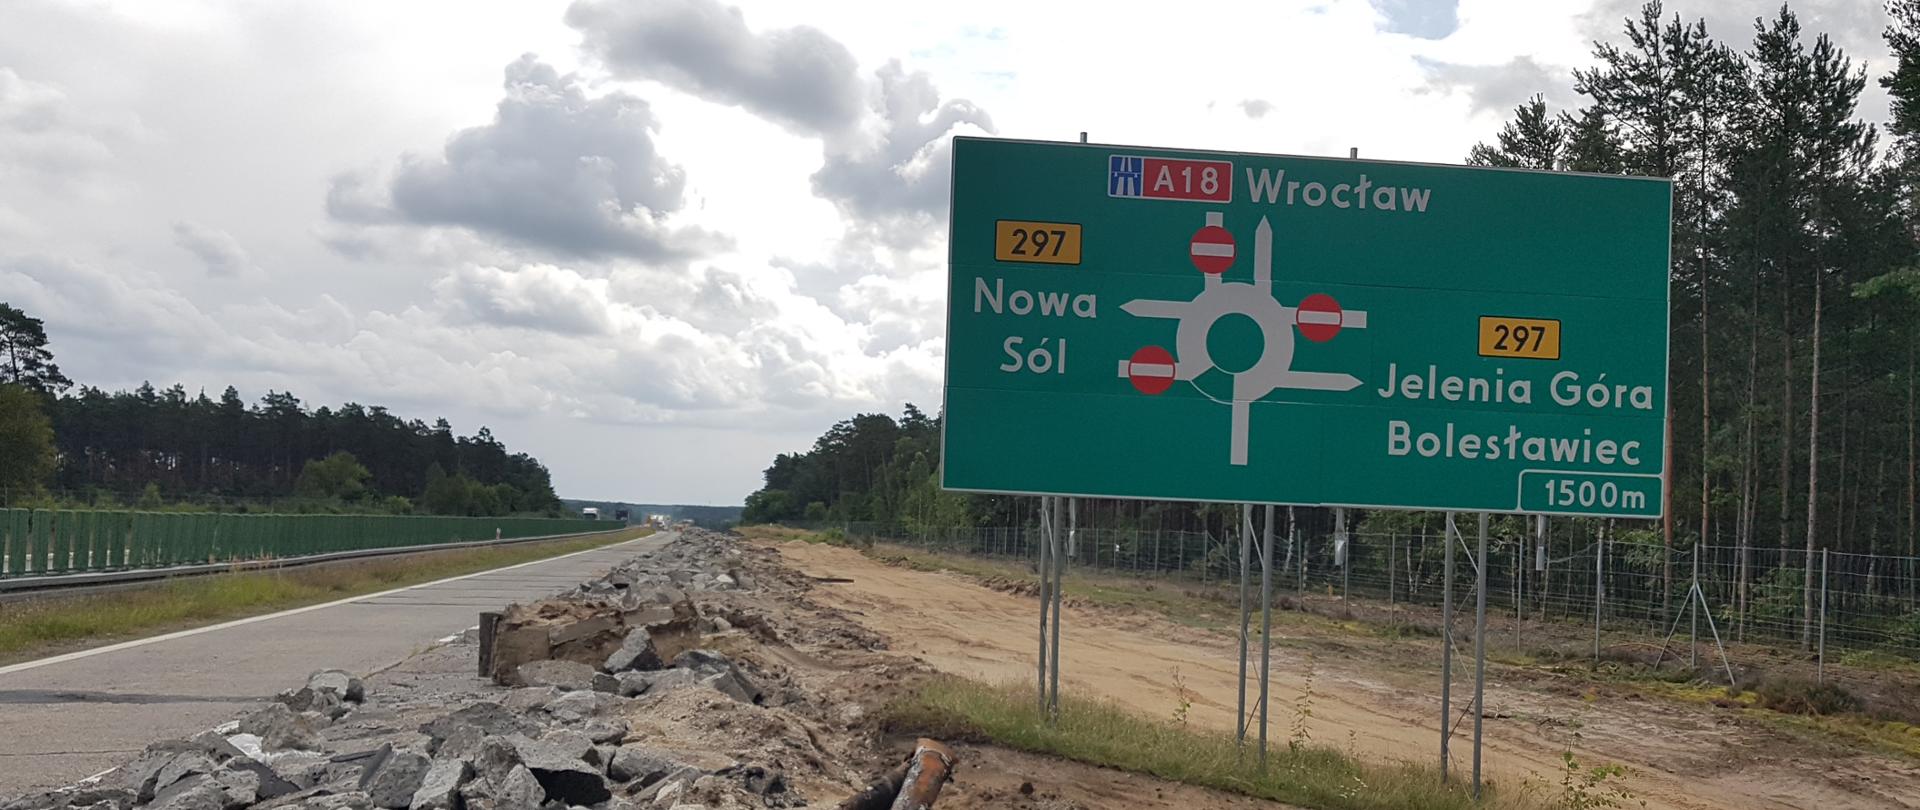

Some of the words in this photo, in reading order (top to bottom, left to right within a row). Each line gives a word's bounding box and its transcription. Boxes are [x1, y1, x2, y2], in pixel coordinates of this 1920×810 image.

[1153, 165, 1219, 195] A18
[1245, 167, 1432, 212] Wrocław
[1010, 228, 1066, 257] 297
[974, 276, 1097, 319] Nowa
[999, 335, 1066, 374] Sól
[1493, 324, 1546, 352] 297
[1377, 362, 1532, 404] Jelenia
[1550, 370, 1653, 410] Góra
[1387, 420, 1641, 466] Bolesławiec
[1545, 479, 1646, 510] 1500m
